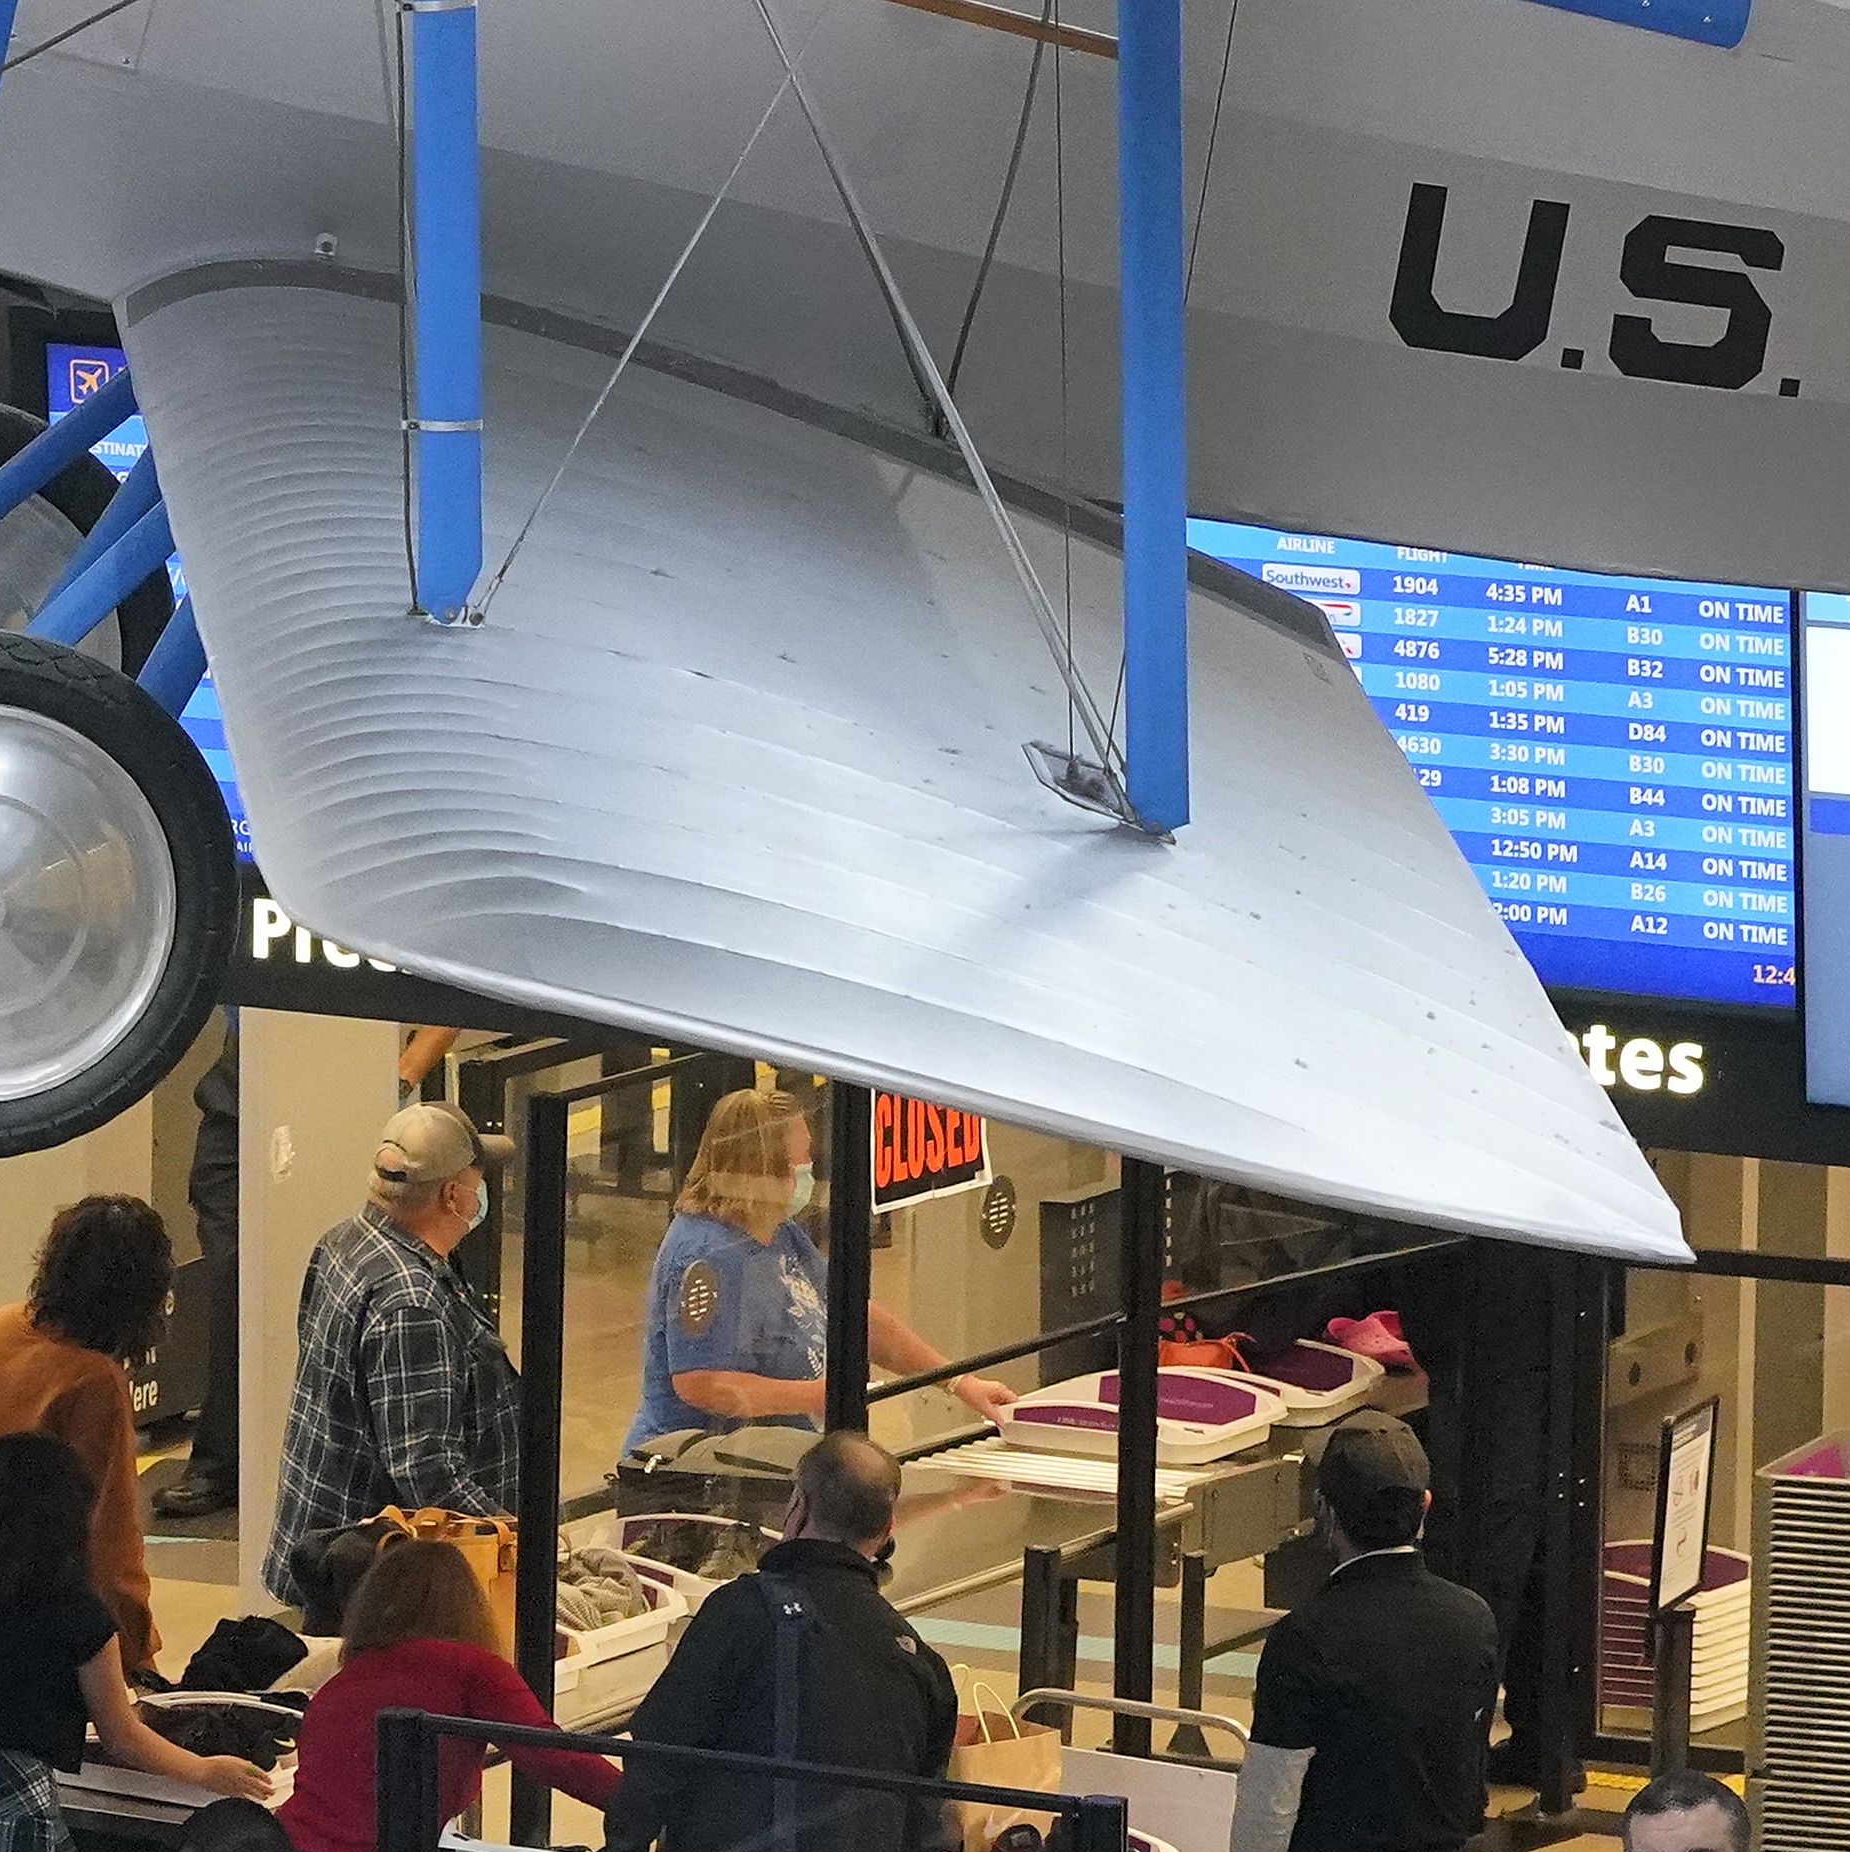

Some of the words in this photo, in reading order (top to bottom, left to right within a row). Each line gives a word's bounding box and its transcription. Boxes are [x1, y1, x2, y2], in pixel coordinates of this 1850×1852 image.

[1388, 181, 1803, 399] U.S.
[1276, 535, 1336, 555] AIRLINE
[1393, 575, 1439, 596] 1904
[1485, 582, 1526, 602] 4:35
[1531, 586, 1562, 606] PM
[1626, 594, 1652, 613] A1
[1698, 600, 1730, 620] ON
[1735, 603, 1784, 624] TIME
[1393, 639, 1440, 660] 4876
[1488, 647, 1527, 666] 5:28
[1533, 650, 1564, 670] PM
[1627, 658, 1663, 679] B32
[1699, 664, 1731, 684] ON
[1735, 667, 1785, 688] TIME
[1568, 1020, 1705, 1095] tes
[875, 1092, 981, 1189] CLOSED
